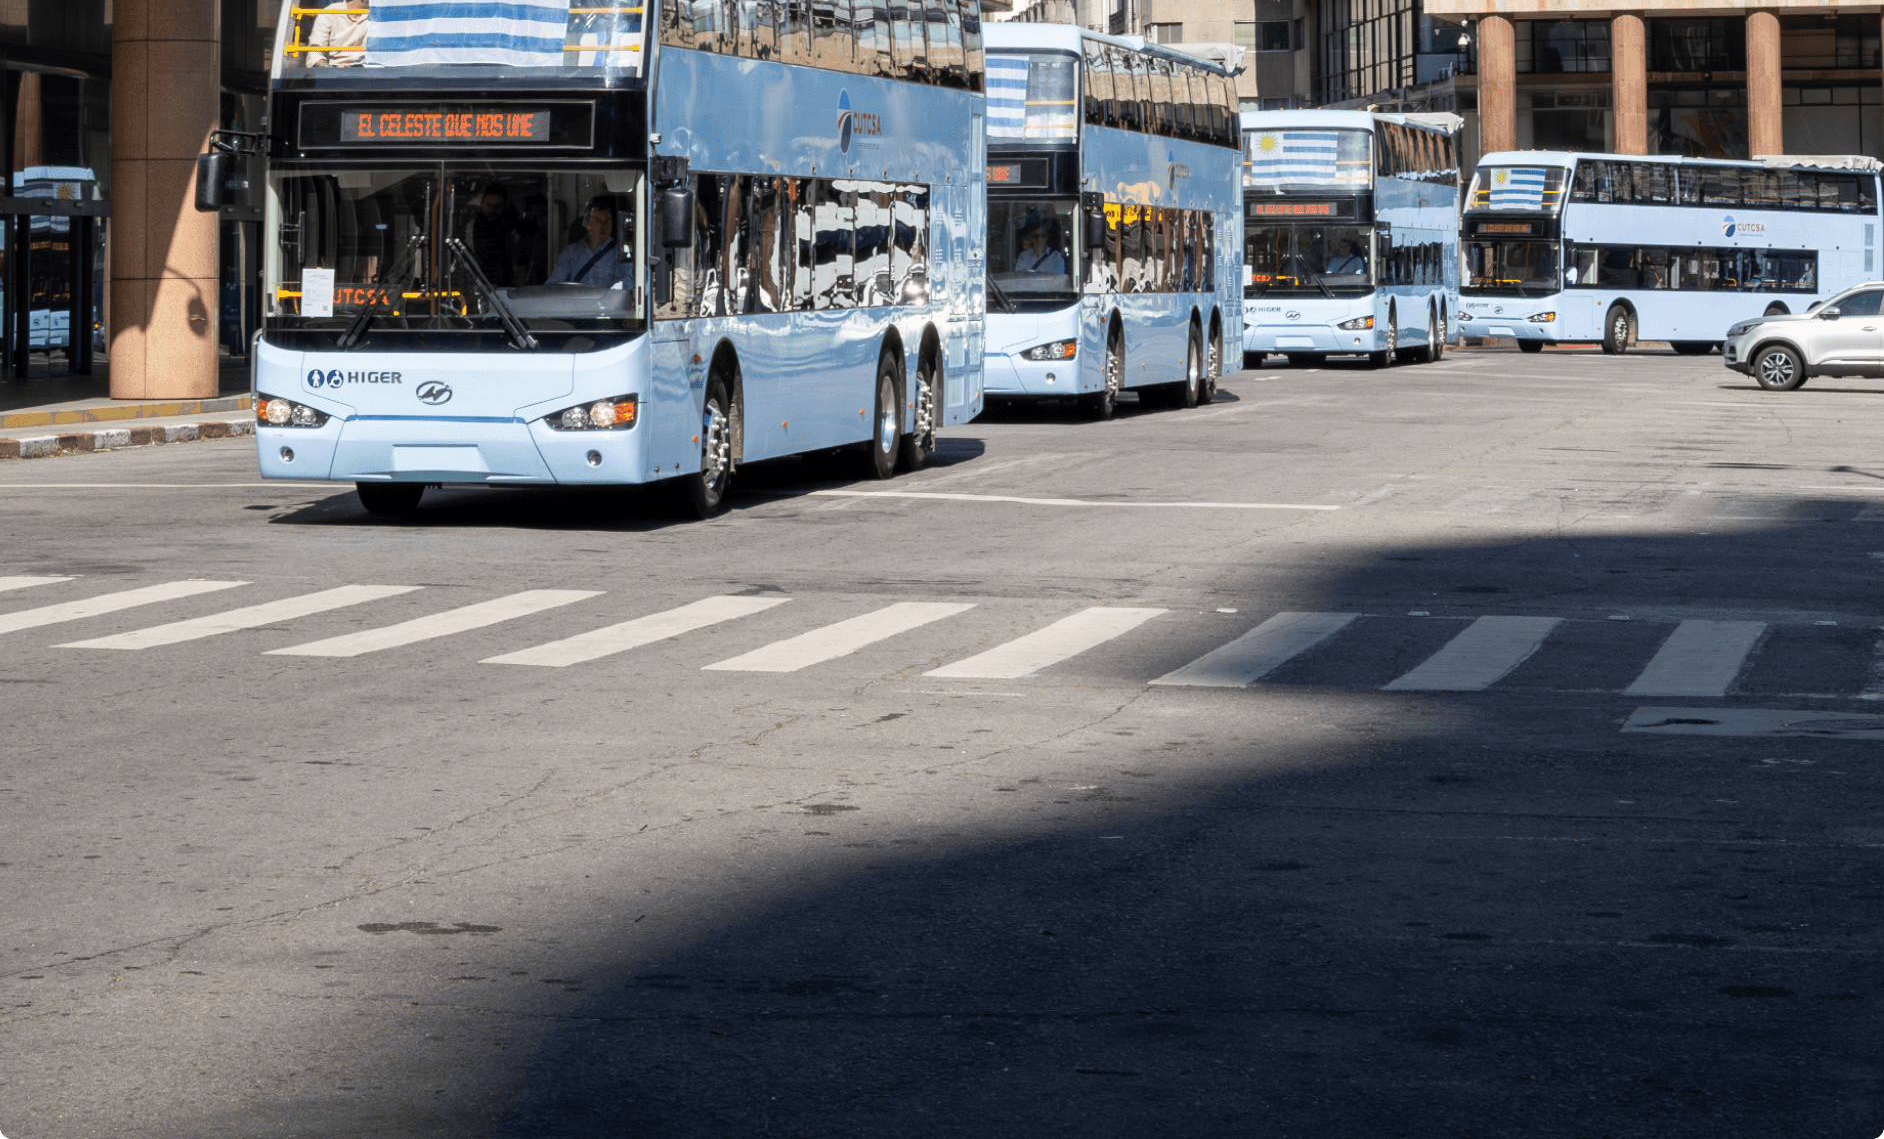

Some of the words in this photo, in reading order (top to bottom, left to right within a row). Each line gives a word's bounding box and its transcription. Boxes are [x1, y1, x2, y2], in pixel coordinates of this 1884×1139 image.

[358, 113, 376, 137] EL
[379, 113, 443, 137] CELESTE
[445, 113, 473, 137] QUE
[475, 113, 504, 137] NOS
[507, 113, 534, 137] UNE
[853, 112, 882, 136] CUTCSA
[1737, 222, 1766, 233] CUTCSA
[347, 371, 403, 384] HIGER
